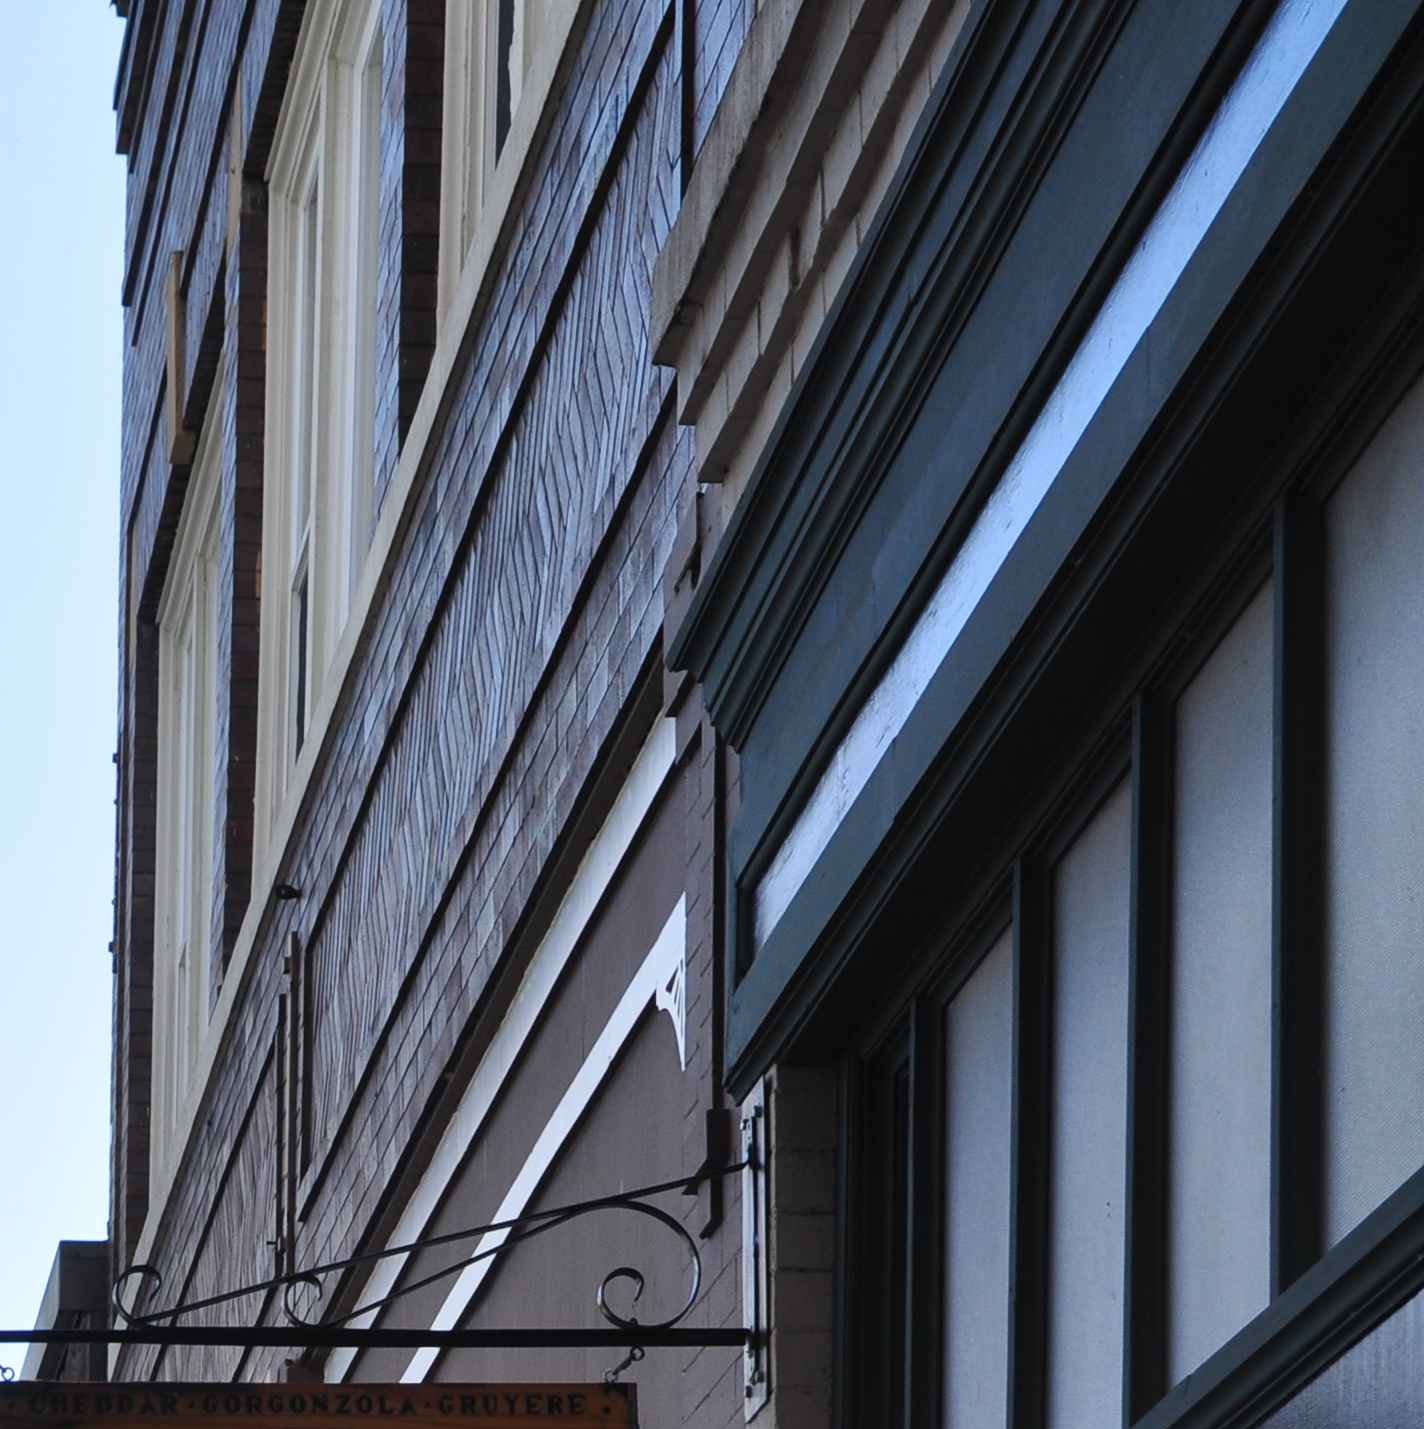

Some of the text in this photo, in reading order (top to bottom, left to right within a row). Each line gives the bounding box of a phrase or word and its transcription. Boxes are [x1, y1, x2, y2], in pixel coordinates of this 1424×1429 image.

[28, 1393, 587, 1416] CHEDDAR GORGONZOLA GRUYERE
